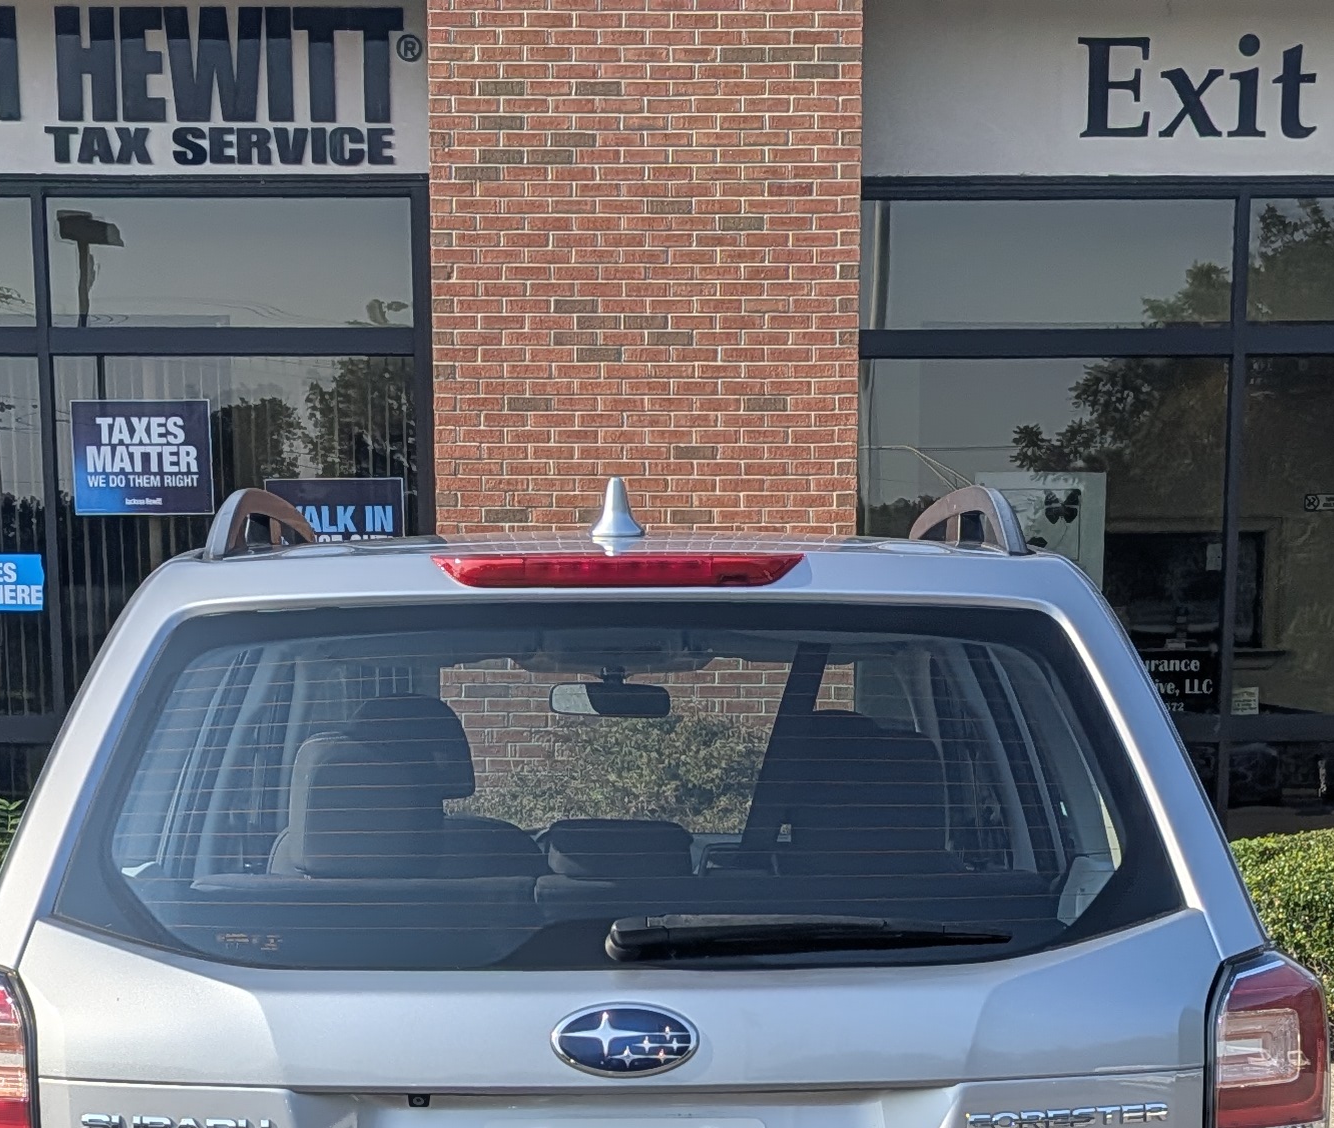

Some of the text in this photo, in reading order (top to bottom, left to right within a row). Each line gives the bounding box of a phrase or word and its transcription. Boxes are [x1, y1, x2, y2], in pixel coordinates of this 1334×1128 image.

[1078, 33, 1317, 139] Exit
[44, 126, 396, 165] TAX SERVICE
[95, 416, 185, 444] TAXES
[86, 445, 199, 473] MATTER
[88, 475, 199, 487] WE DO THEM RIGHT
[365, 505, 394, 532] IN
[1184, 679, 1213, 695] LLC
